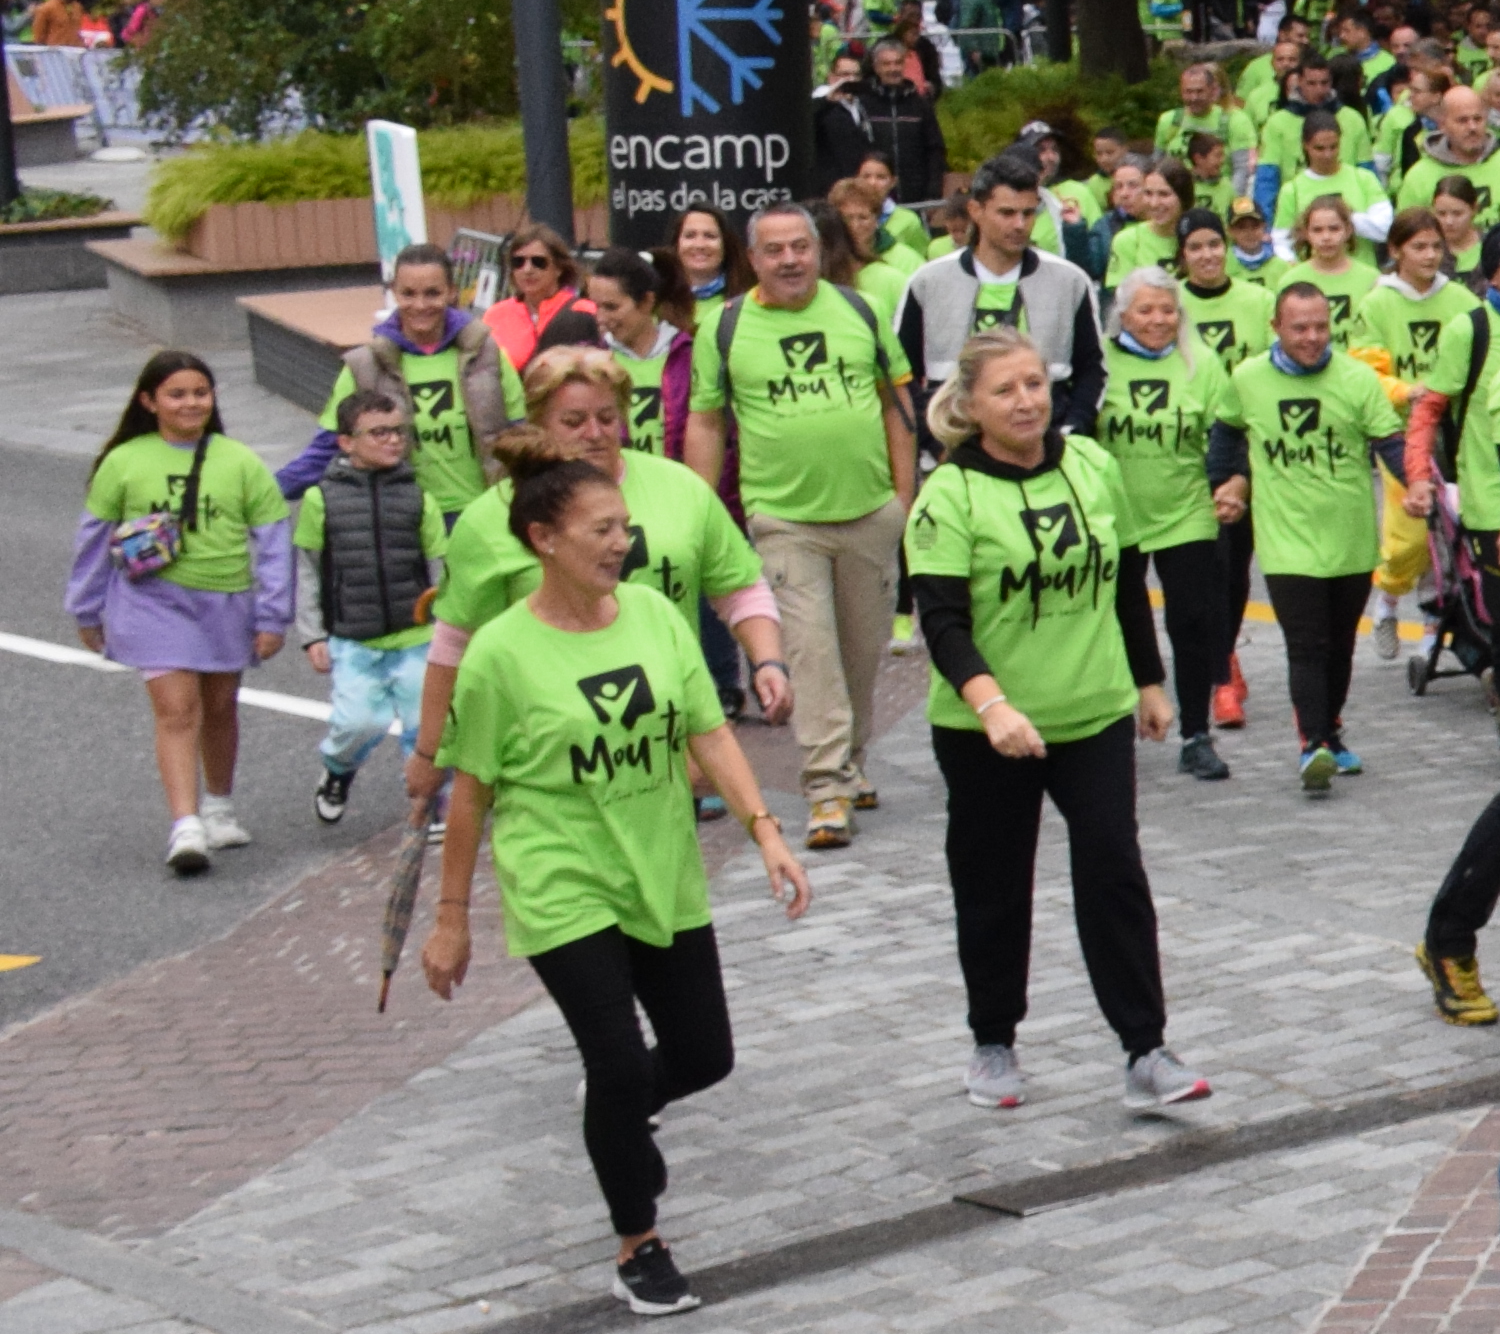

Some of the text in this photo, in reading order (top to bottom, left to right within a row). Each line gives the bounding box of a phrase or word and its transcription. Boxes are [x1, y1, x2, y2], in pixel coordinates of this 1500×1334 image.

[610, 133, 790, 182] encamp
[628, 186, 666, 218] pas
[713, 180, 736, 211] la
